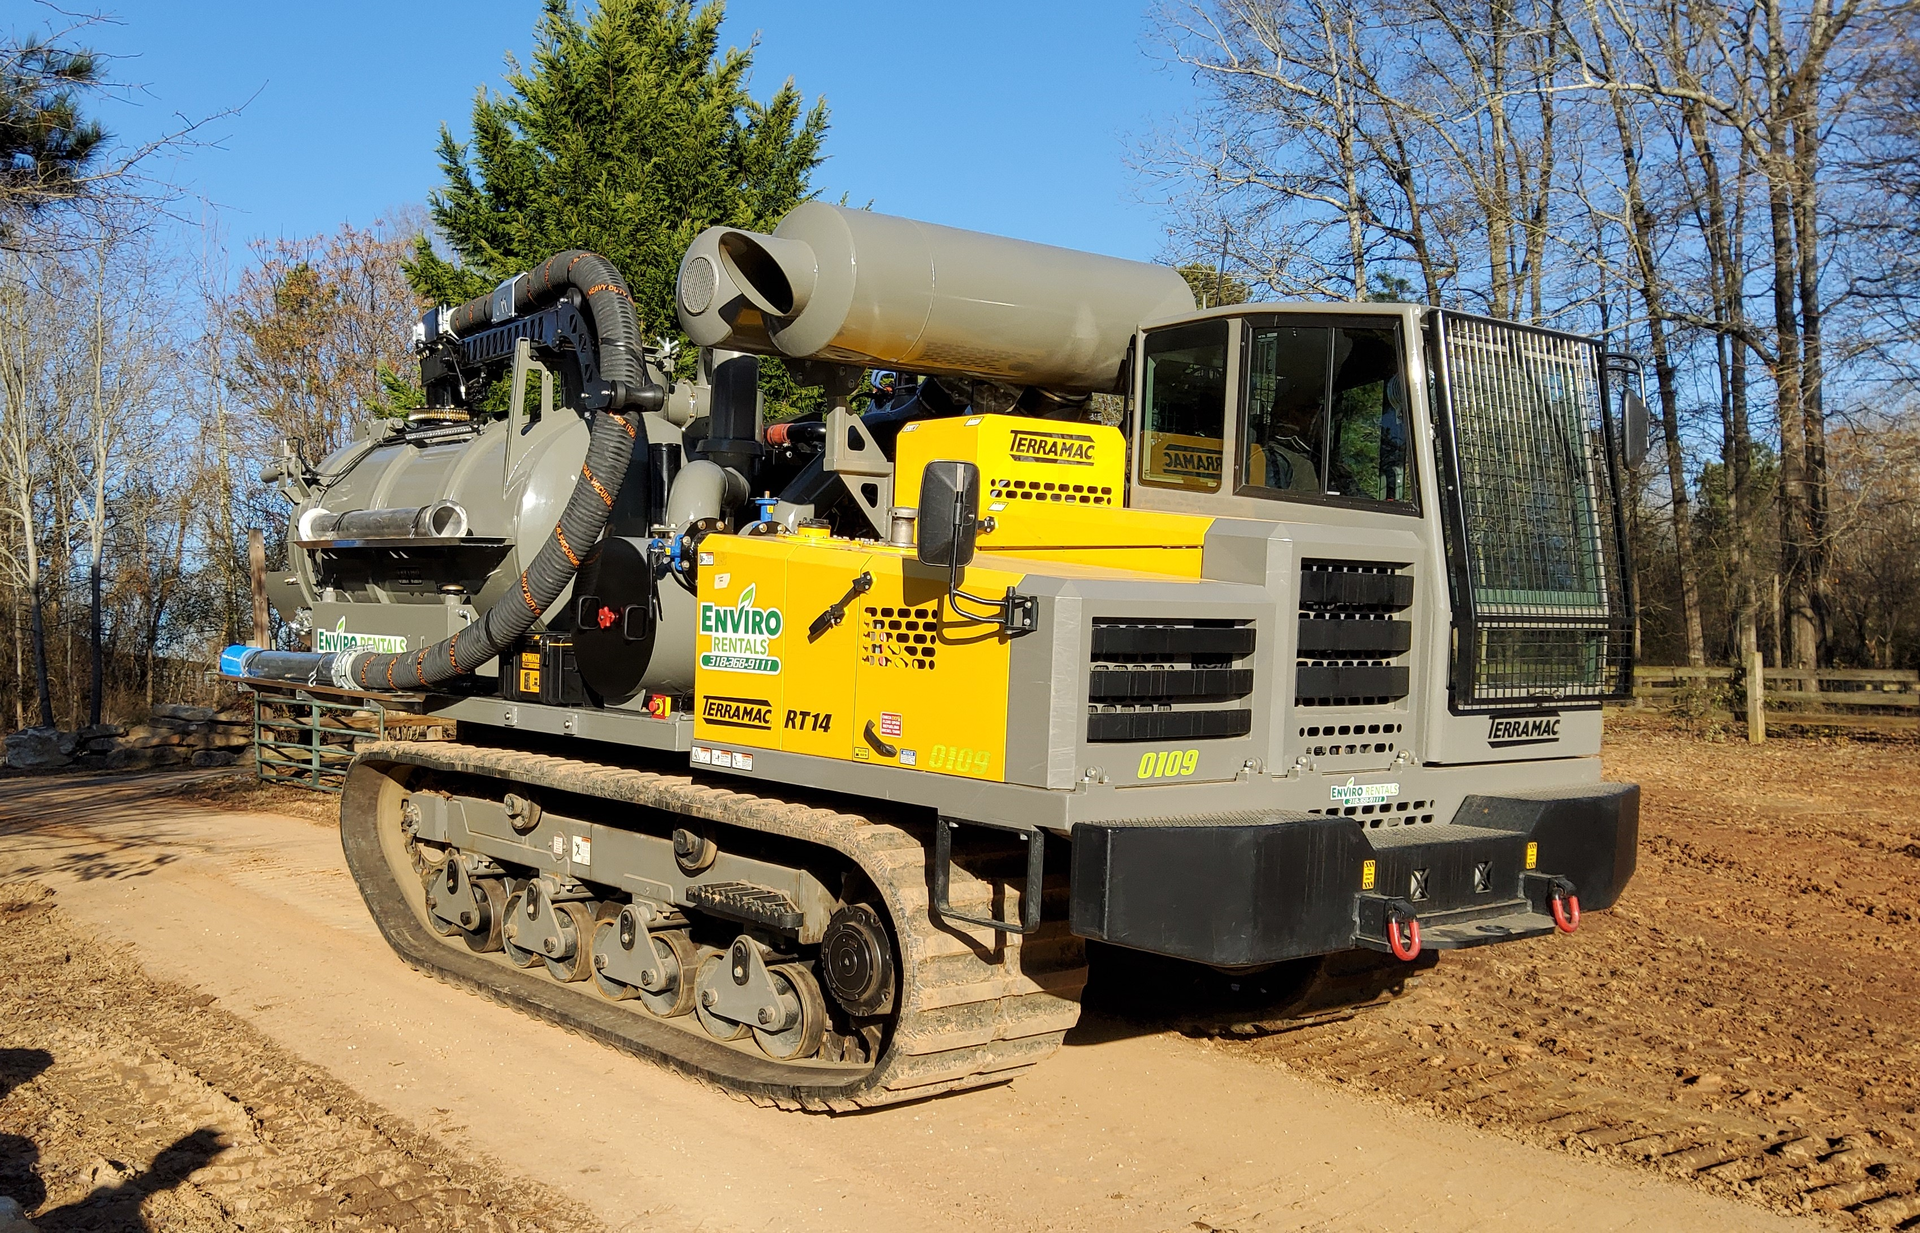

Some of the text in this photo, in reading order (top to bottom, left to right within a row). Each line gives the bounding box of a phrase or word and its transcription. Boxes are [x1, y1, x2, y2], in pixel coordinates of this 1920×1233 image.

[1009, 429, 1096, 461] TERRAMAC
[702, 603, 782, 636] ENVIRO
[318, 631, 358, 652] ENVIRO
[713, 636, 767, 656] RENTALS
[708, 656, 772, 671] 318-368-9111
[703, 695, 833, 733] TERRAMAC RT14
[1488, 712, 1561, 739] TERRAMAC
[928, 744, 991, 775] 0109
[1137, 749, 1199, 778] 0109
[1331, 784, 1399, 799] ENVIRO RENTALS
